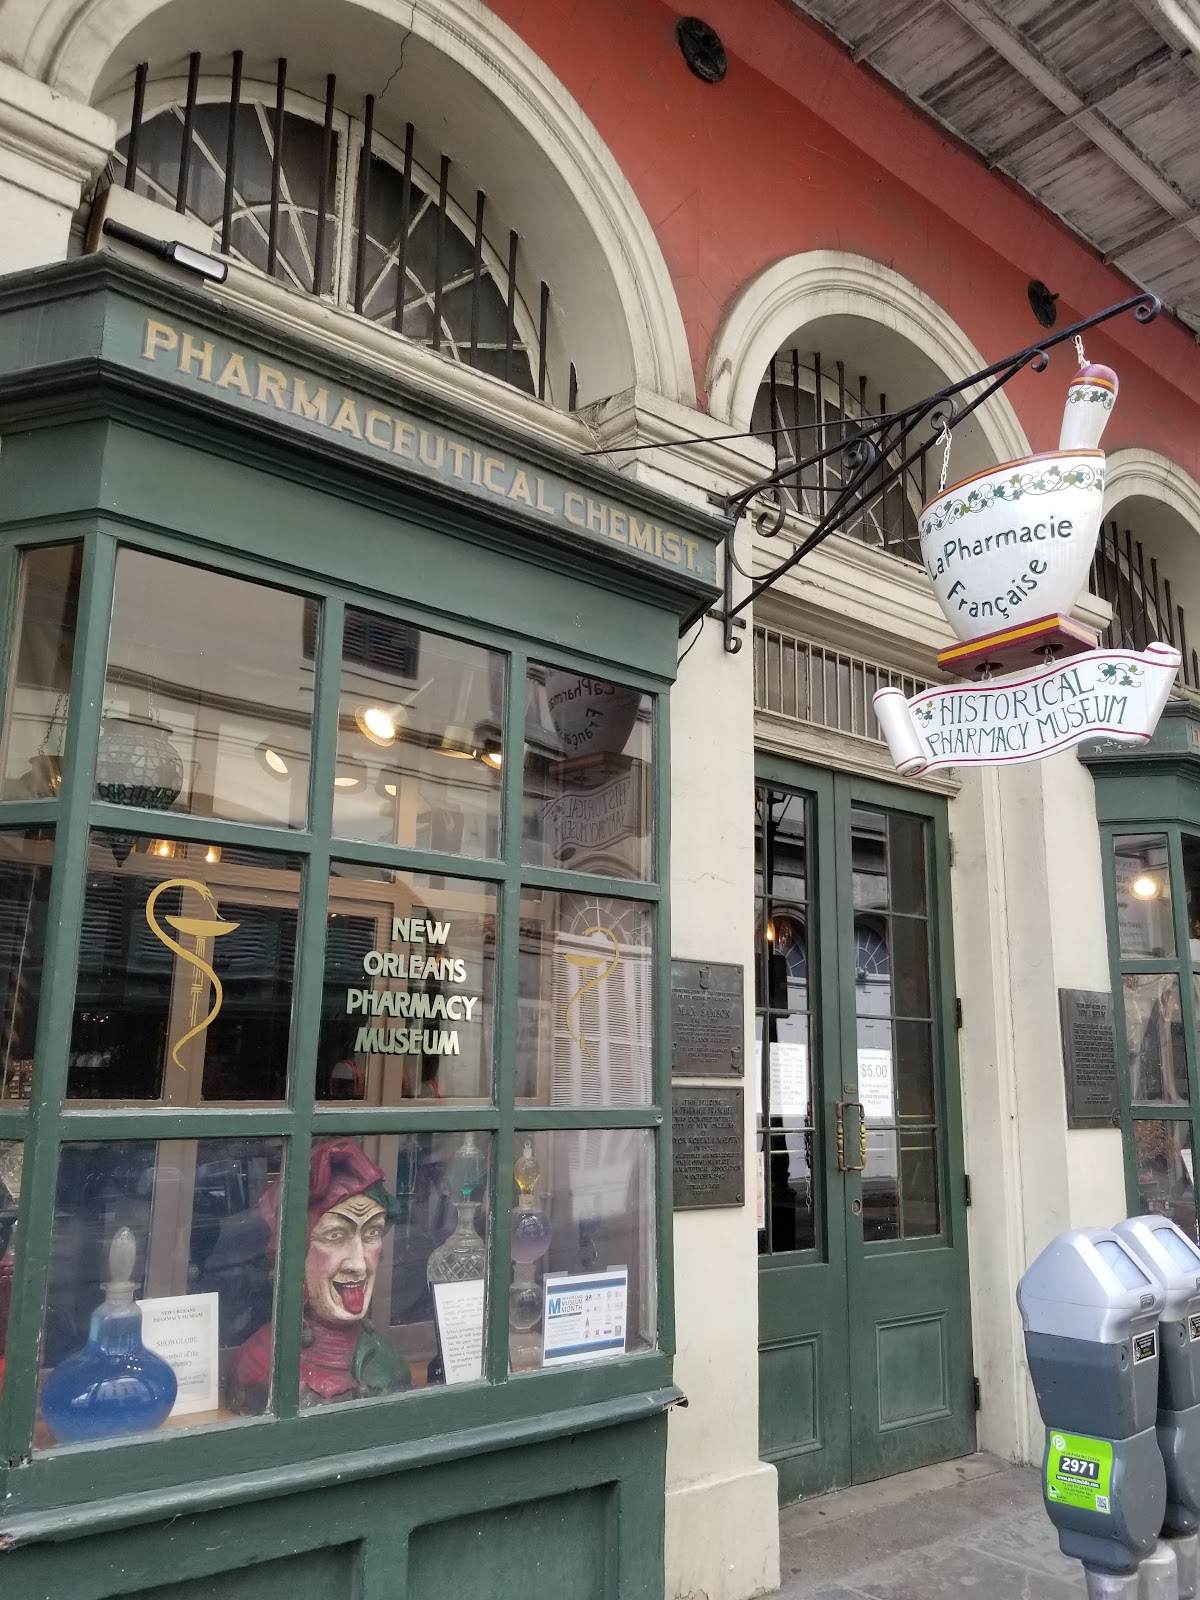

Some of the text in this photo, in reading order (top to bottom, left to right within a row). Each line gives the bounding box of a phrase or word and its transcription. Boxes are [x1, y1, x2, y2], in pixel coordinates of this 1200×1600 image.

[141, 318, 703, 573] PHARMACEUTICAL CHEMIST.
[927, 515, 1073, 582] La Pharmacie
[947, 558, 1048, 620] Française
[938, 667, 1095, 727] HISTORICAL
[925, 694, 1129, 757] PHARMACY MUSEUM
[391, 917, 451, 945] NEW
[363, 950, 467, 983] ORLEANS
[346, 988, 478, 1021] PHARMACY
[354, 1026, 460, 1055] MUSEUM
[861, 1063, 888, 1078] $5.00
[153, 1314, 181, 1323] PHARMACY
[561, 1305, 583, 1313] MONTH
[157, 1336, 199, 1347] SHOWGLOBE
[1061, 1457, 1095, 1476] 2971
[1056, 1474, 1099, 1488] www.parkmobile.com
[1079, 1485, 1093, 1493] parking
